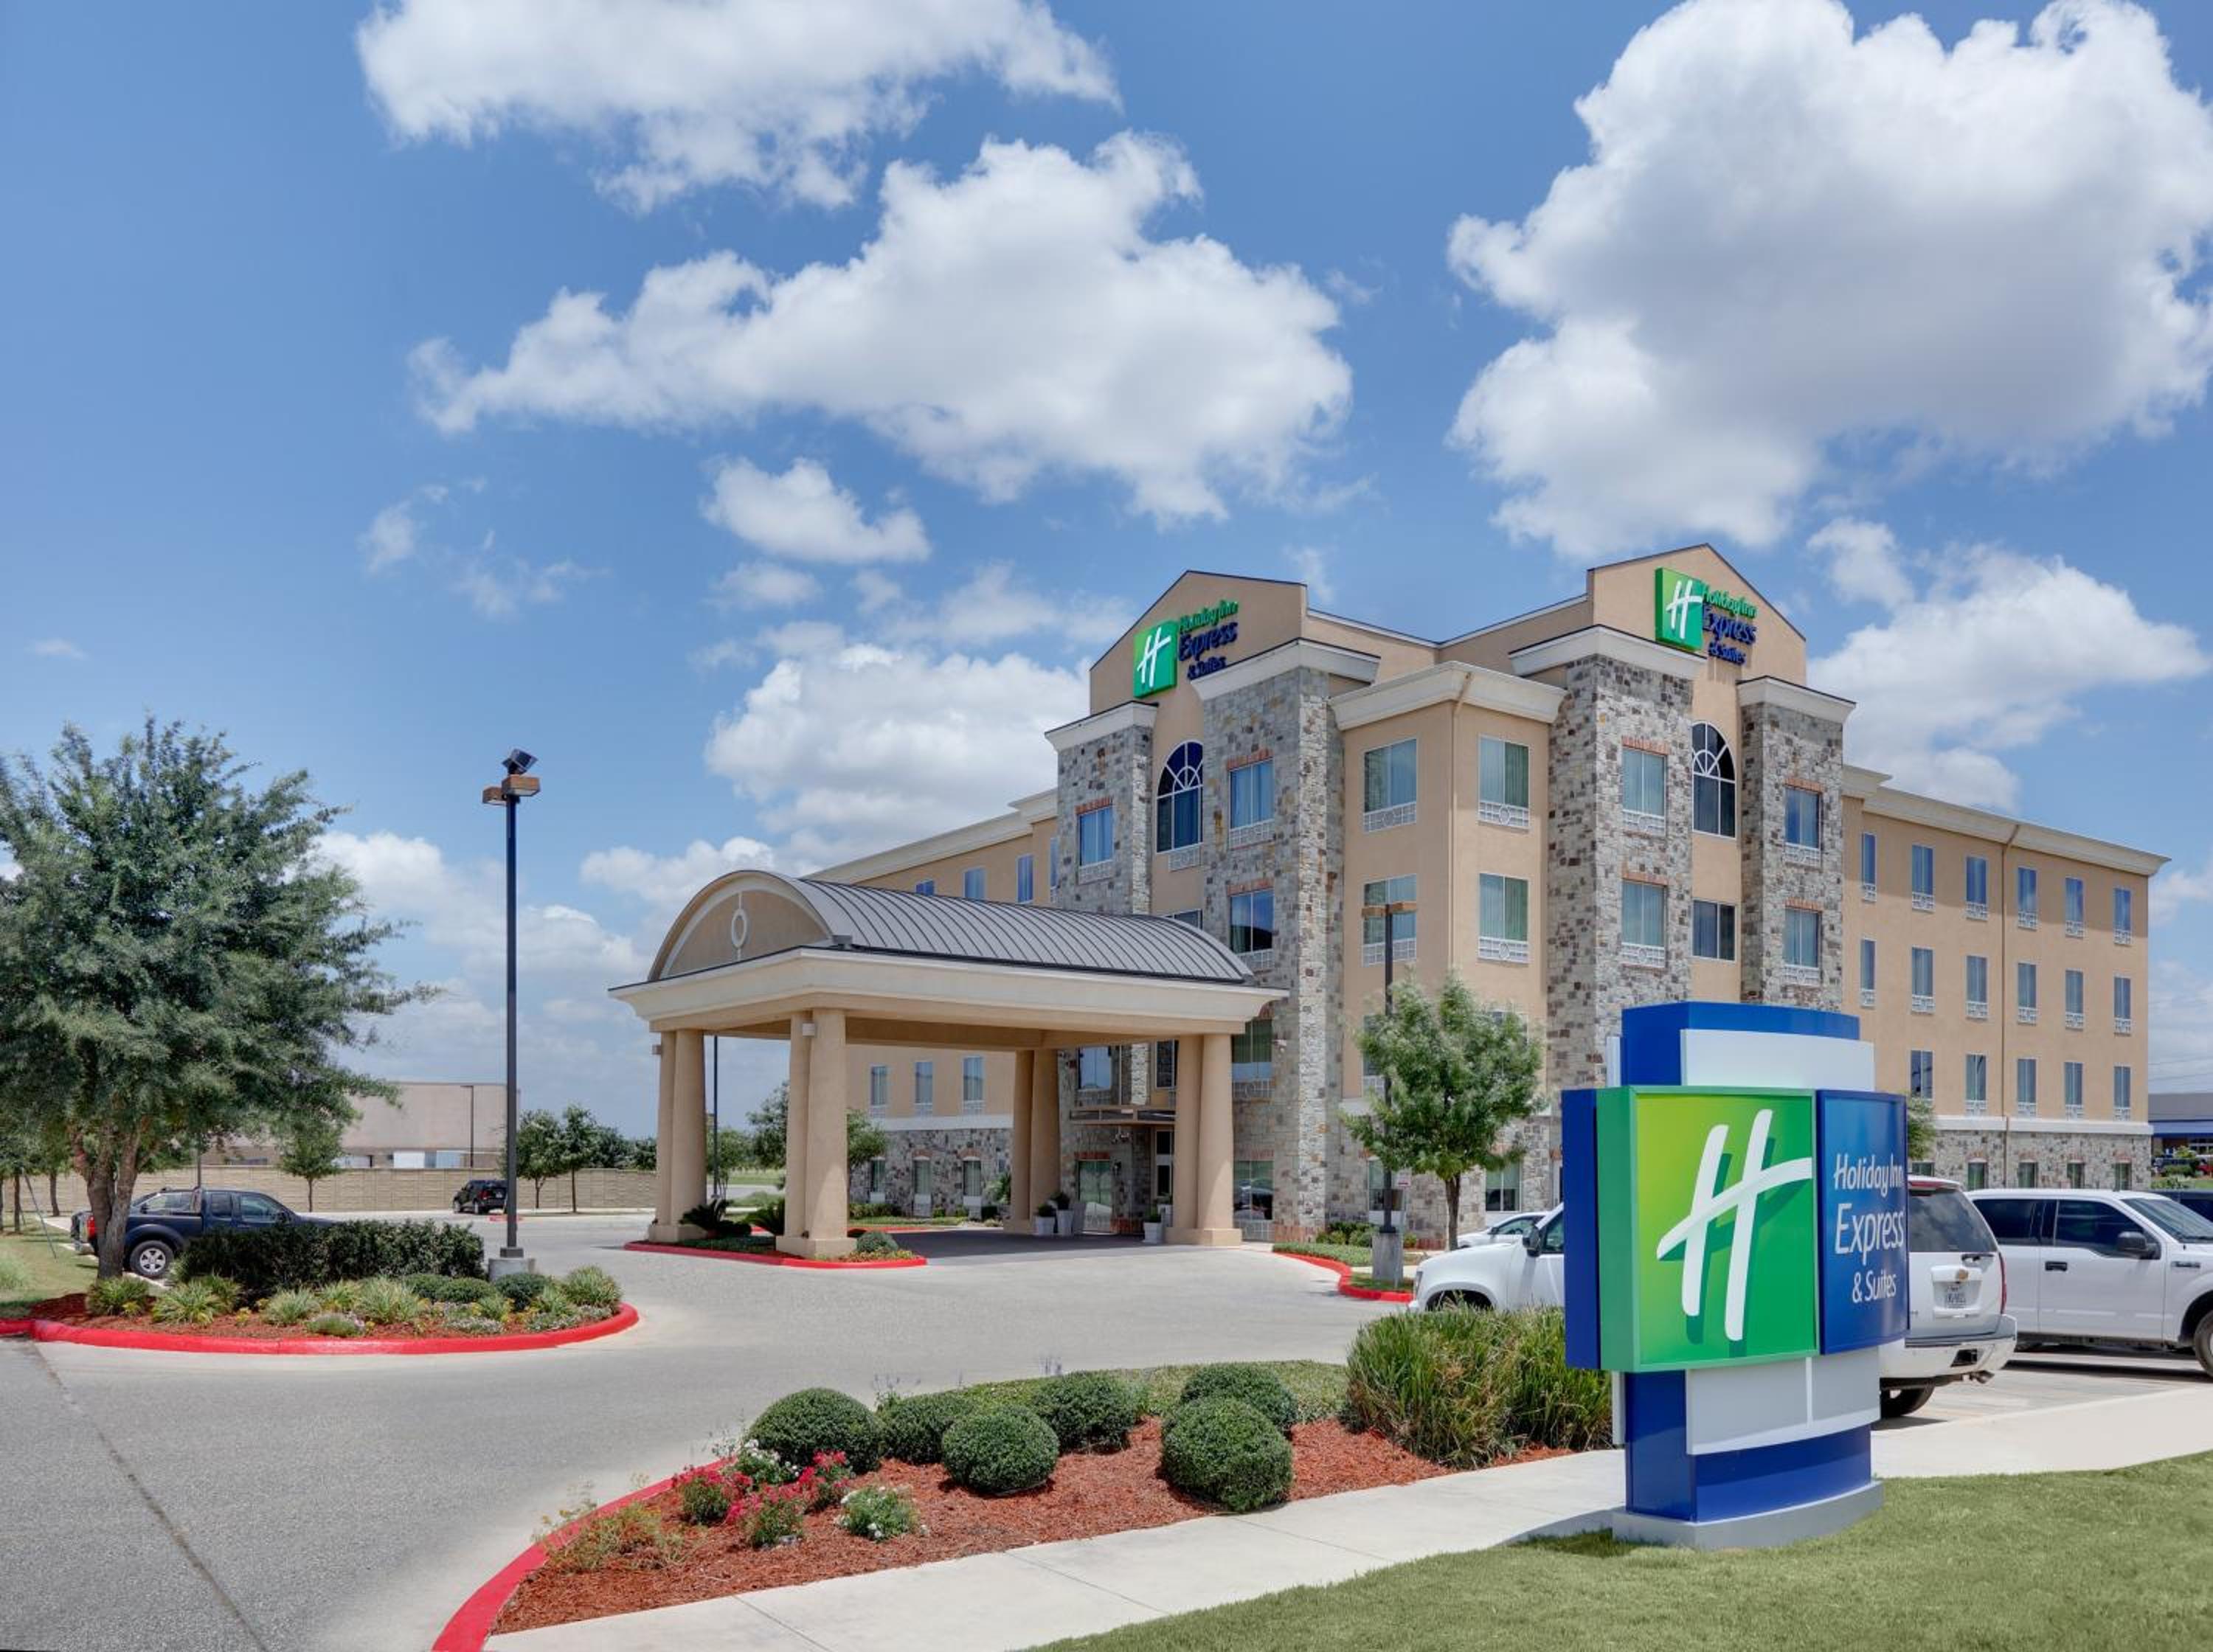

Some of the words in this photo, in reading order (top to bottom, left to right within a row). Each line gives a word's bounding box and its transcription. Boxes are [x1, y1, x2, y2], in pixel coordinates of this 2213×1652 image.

[1180, 608, 1219, 634] Holiday
[1219, 600, 1239, 619] Inn
[1701, 584, 1738, 617] Holiday
[1739, 597, 1757, 620] Inn
[1178, 622, 1239, 662] Express
[1703, 603, 1757, 645] Express
[1196, 656, 1227, 678] Suites
[1717, 642, 1746, 665] Suites
[1833, 1153, 1889, 1198] Holiday
[1890, 1153, 1904, 1188] Inn
[1835, 1202, 1905, 1266] Express
[1852, 1271, 1863, 1304] &
[1864, 1269, 1897, 1302] Suites
